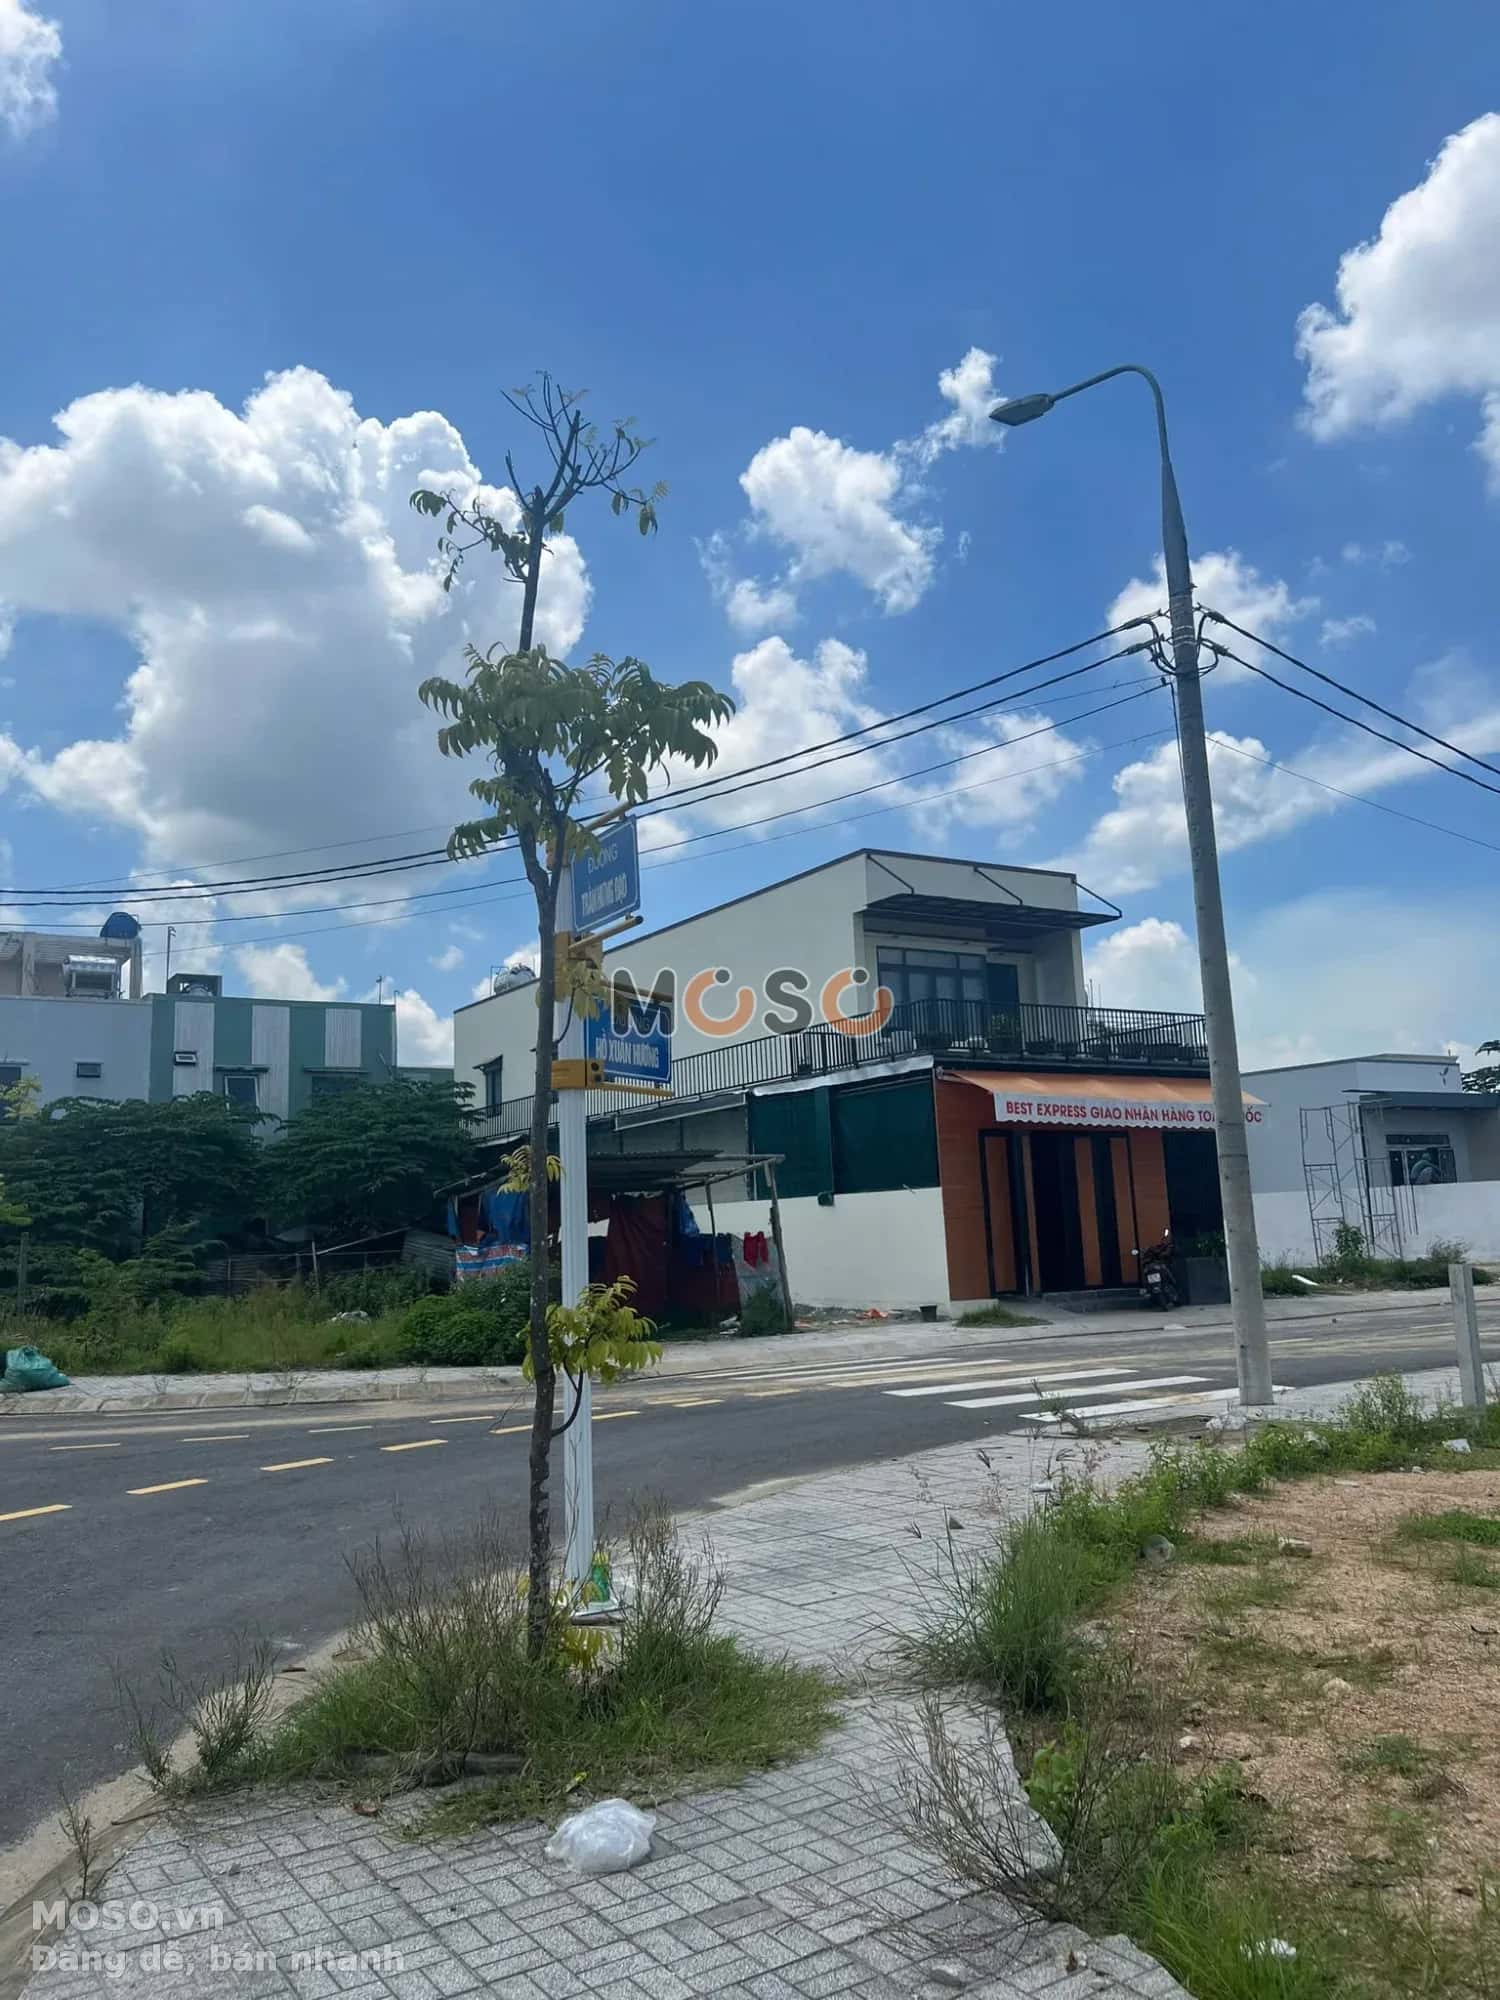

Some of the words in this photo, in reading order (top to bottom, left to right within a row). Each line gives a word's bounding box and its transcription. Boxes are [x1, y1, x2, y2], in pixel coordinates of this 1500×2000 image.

[595, 1027, 608, 1061] HỒ
[608, 1039, 632, 1065] XUÂN
[633, 1043, 659, 1068] HƯƠNG
[1006, 1101, 1033, 1115] BEST
[1037, 1103, 1087, 1119] EXPRESS
[1091, 1106, 1122, 1120] GIAO
[1125, 1106, 1158, 1124] NHẬN
[1162, 1106, 1195, 1122] HÀNG
